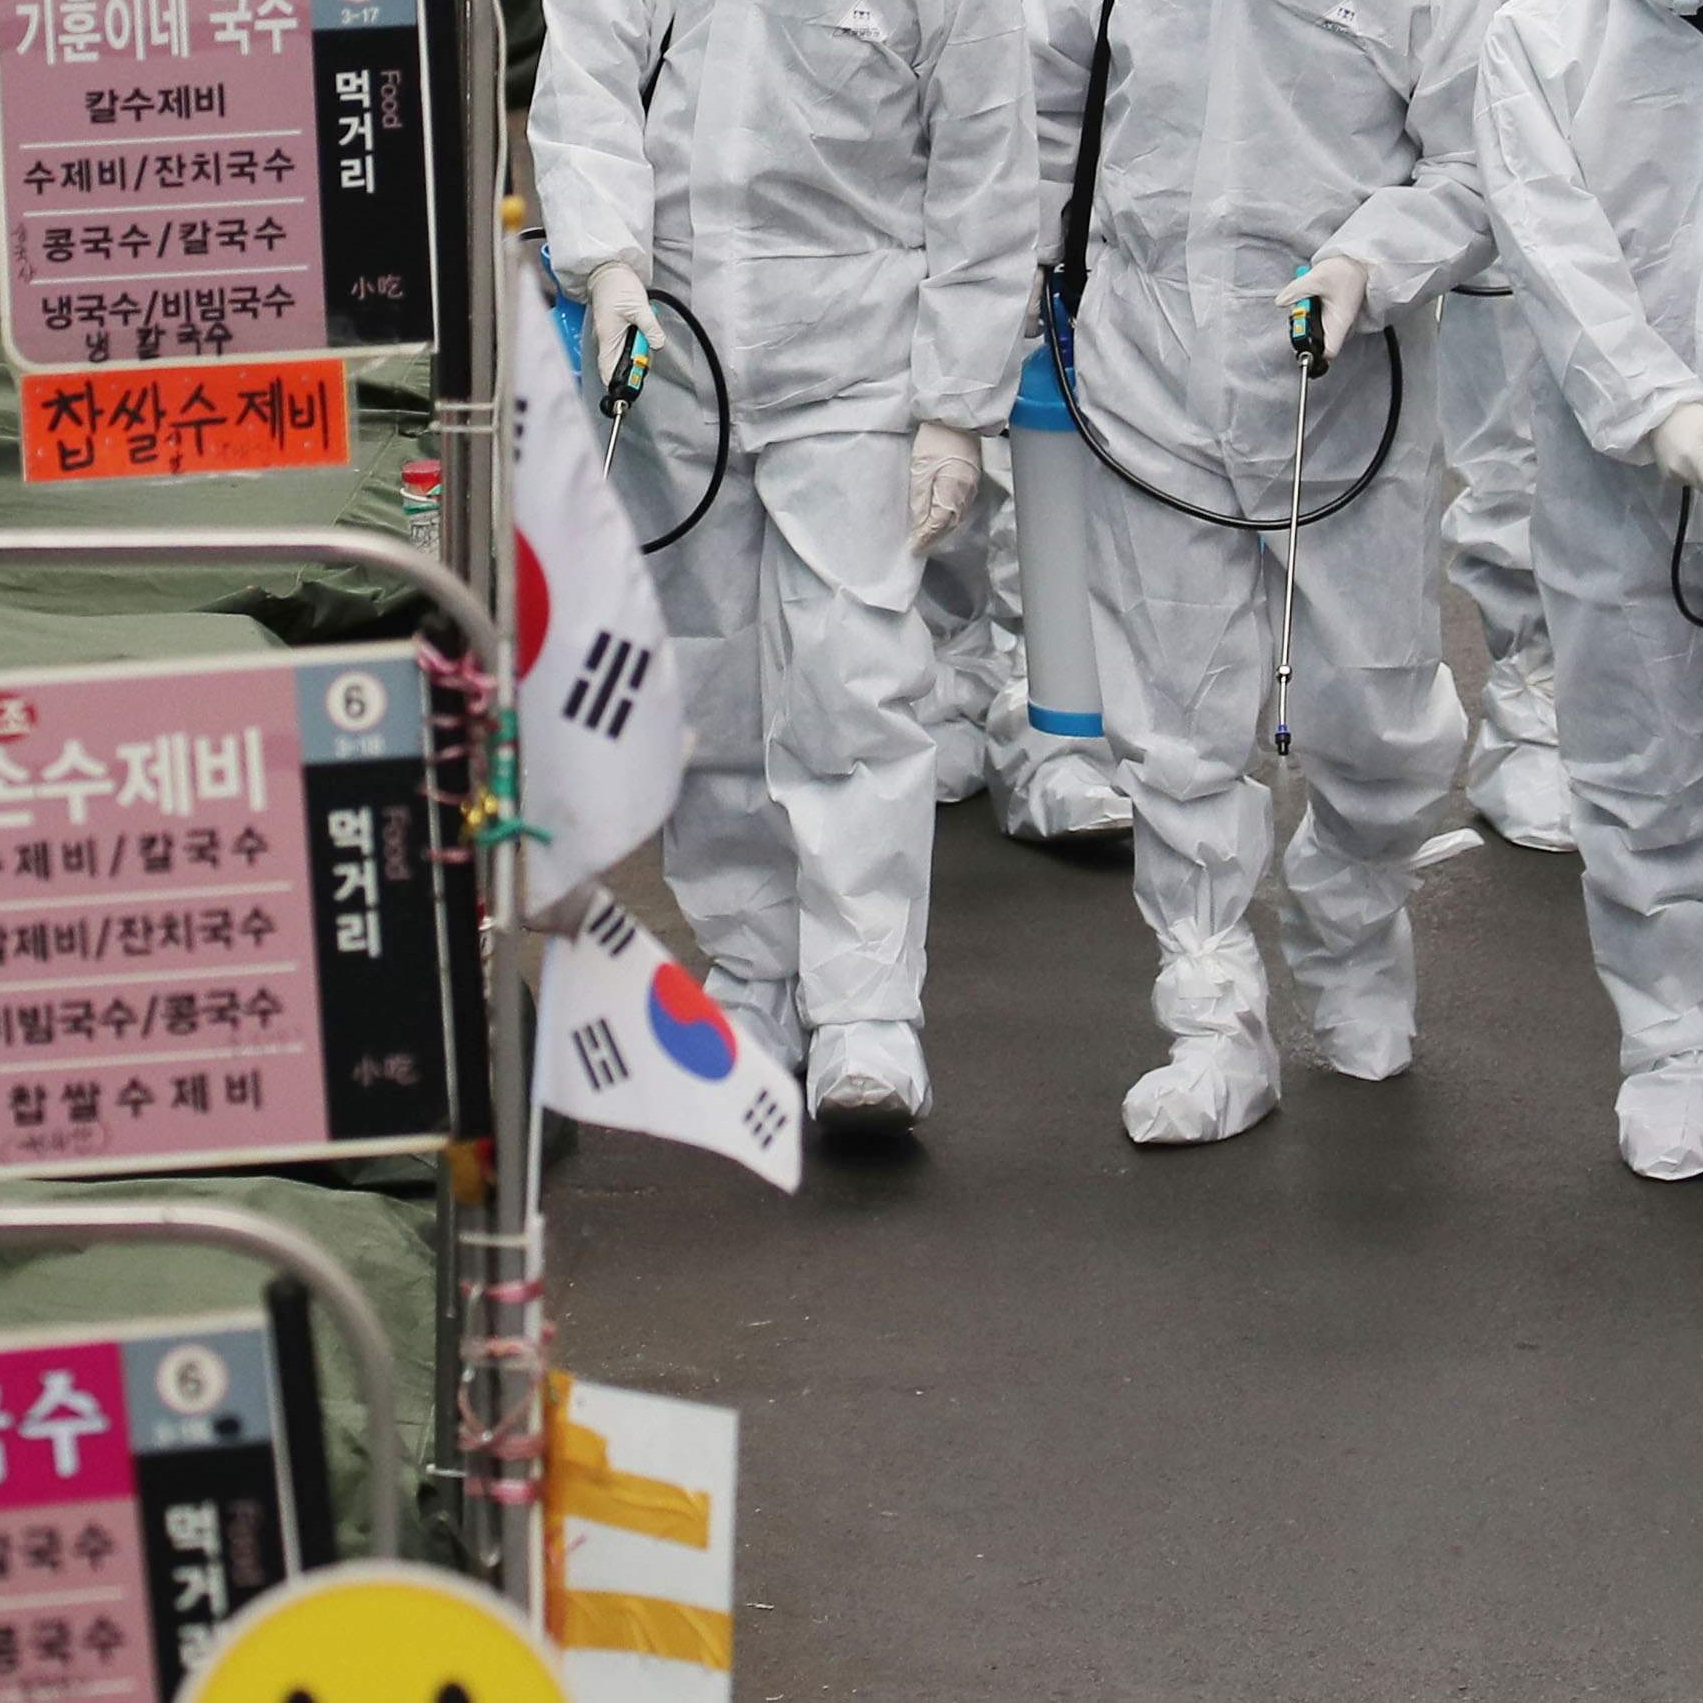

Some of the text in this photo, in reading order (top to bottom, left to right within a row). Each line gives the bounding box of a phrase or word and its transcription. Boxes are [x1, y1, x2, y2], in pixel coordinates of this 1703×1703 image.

[341, 5, 381, 25] 3-17
[85, 82, 227, 125] 칼수제비
[380, 68, 402, 130] Food
[335, 68, 376, 195] 먹거리
[23, 148, 297, 195] 수제비/잔치국수
[42, 217, 288, 263] 콩국수/칼국수
[41, 283, 297, 331] 냉국수/비빔국수
[351, 274, 403, 301] 小吃
[43, 379, 330, 472] 찹쌀수제비
[344, 685, 367, 719] 6
[328, 807, 383, 960] 먹거리
[176, 1362, 201, 1399] 6
